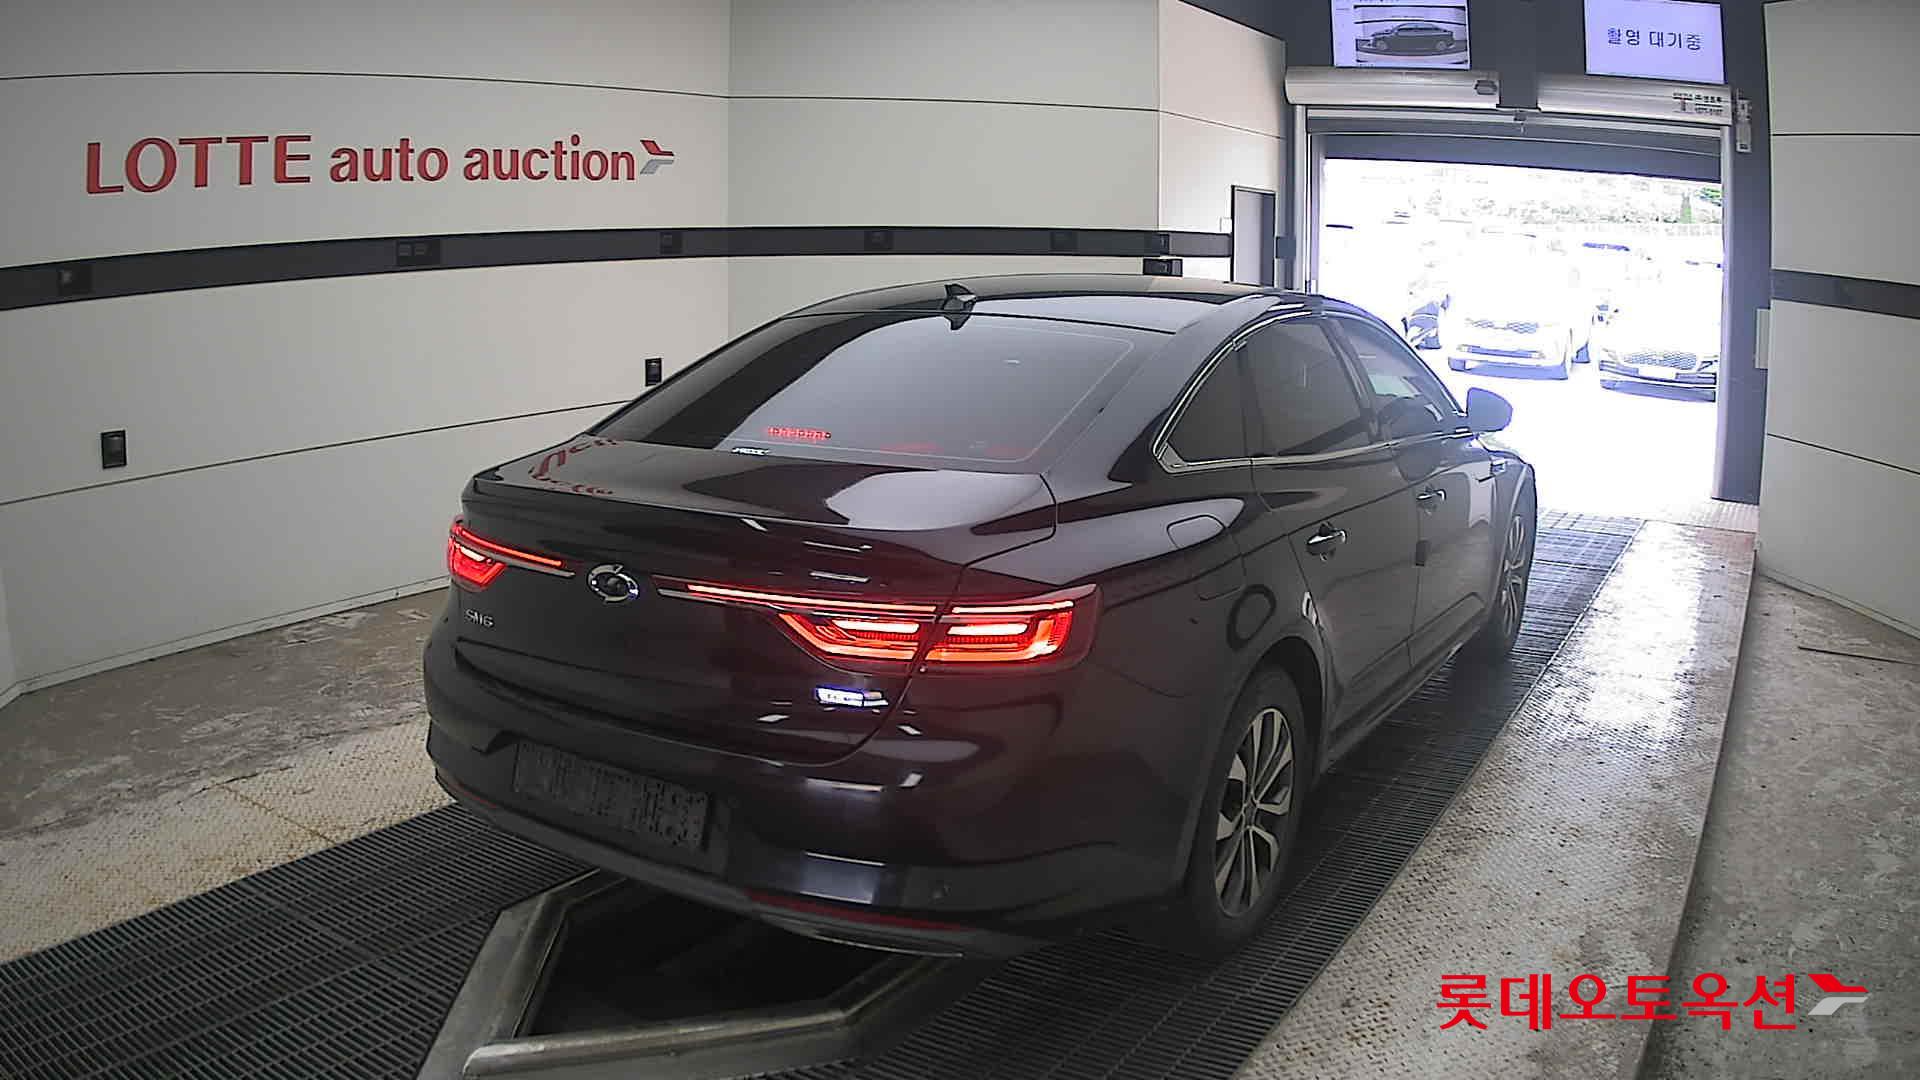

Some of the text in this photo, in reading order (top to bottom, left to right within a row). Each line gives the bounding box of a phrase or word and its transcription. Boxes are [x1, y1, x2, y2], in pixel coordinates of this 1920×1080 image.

[86, 133, 636, 195] LOTTE auto auction
[465, 608, 494, 628] SM6
